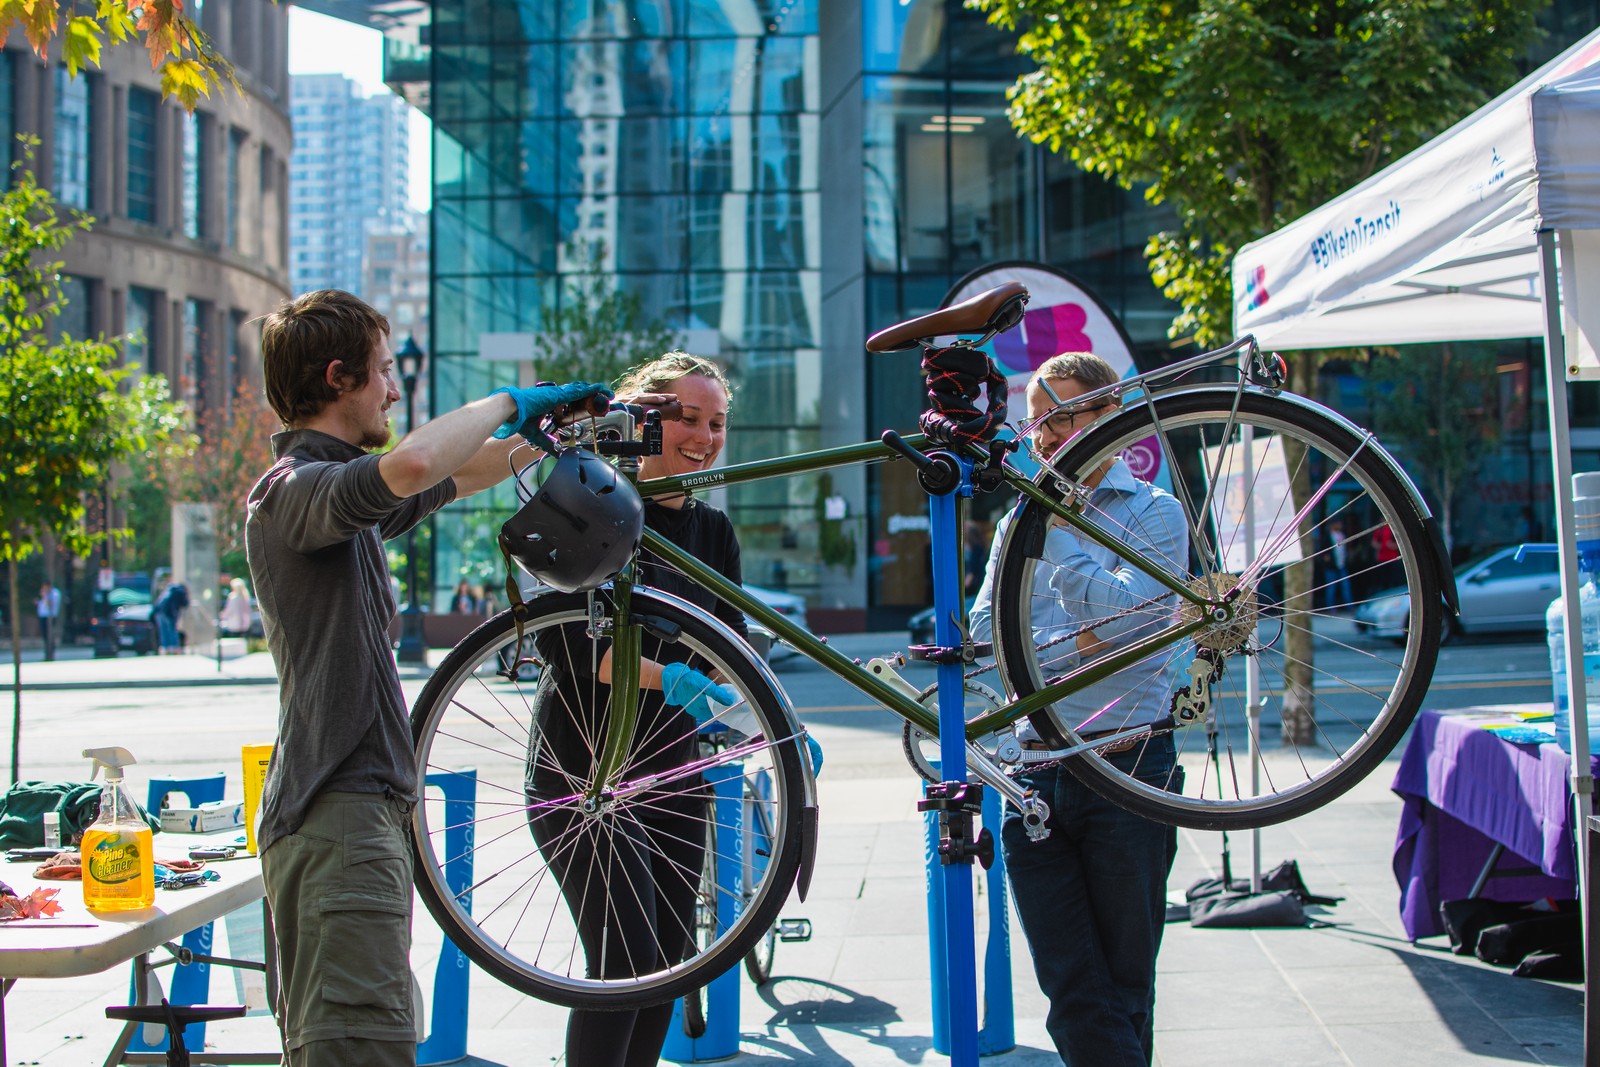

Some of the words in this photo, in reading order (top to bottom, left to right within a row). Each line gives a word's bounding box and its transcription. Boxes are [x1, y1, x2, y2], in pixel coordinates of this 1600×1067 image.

[682, 474, 725, 487] BROOKLYN
[103, 848, 125, 863] Pine
[97, 859, 134, 878] Cleaner
